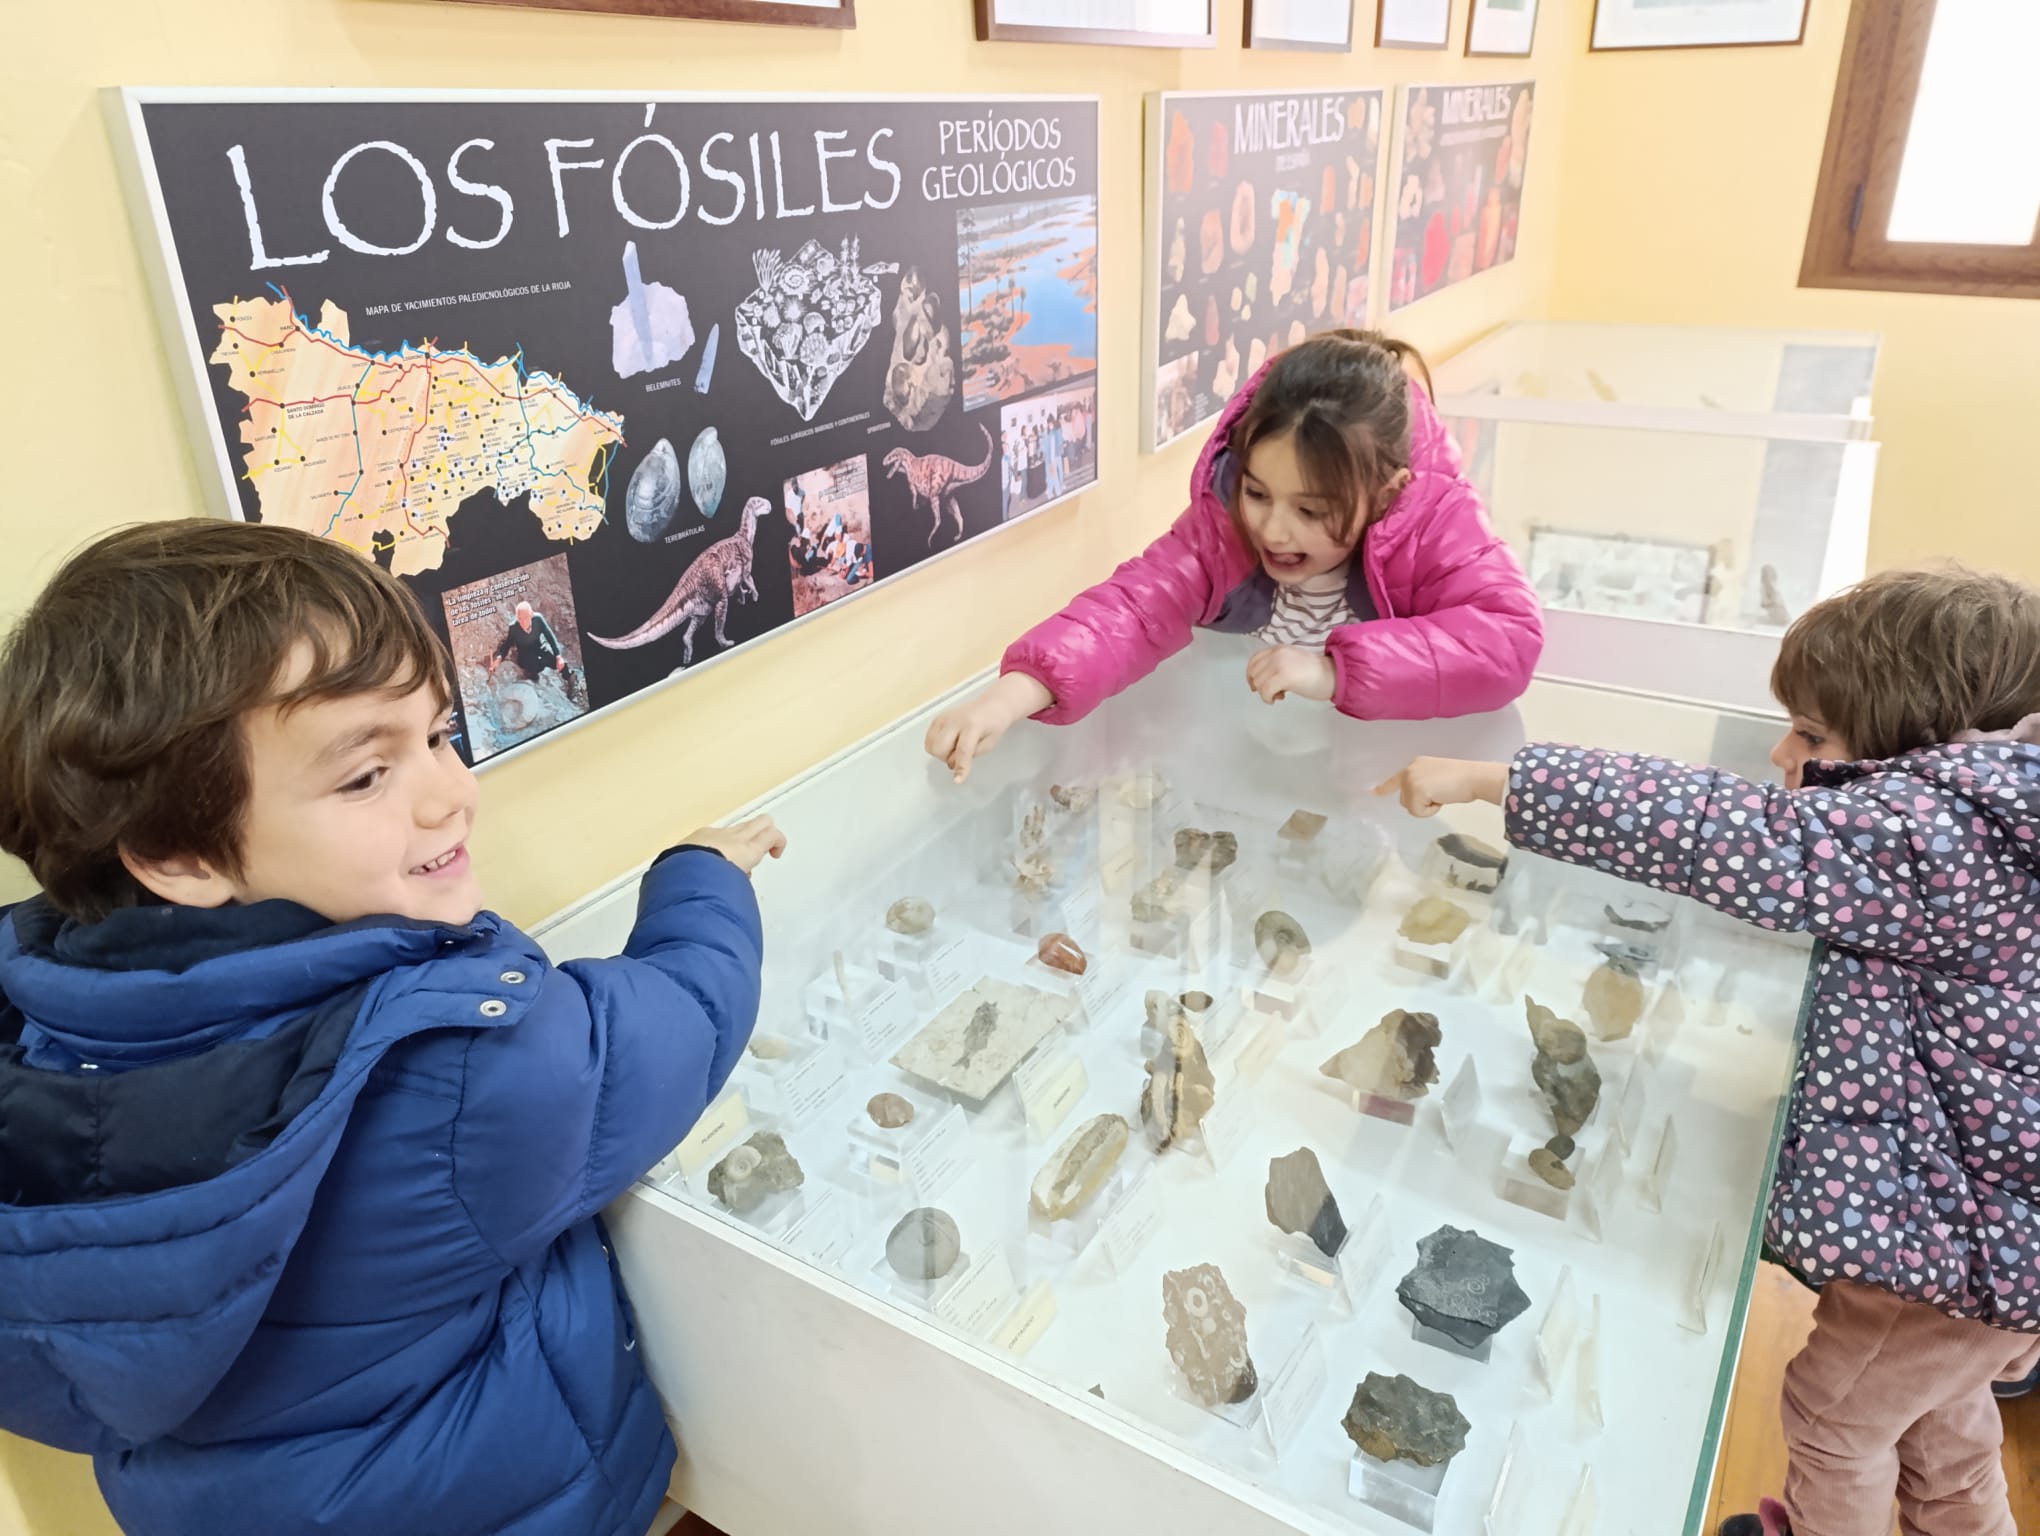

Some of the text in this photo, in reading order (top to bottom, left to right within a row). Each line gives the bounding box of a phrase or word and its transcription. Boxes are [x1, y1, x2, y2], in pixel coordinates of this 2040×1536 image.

[938, 109, 1062, 155] PERÍODOS
[1234, 96, 1345, 154] MINERALES
[226, 103, 901, 270] LOS FÓSILES
[922, 149, 1077, 202] GEOLÓGICOS
[365, 281, 572, 316] MAPA DE YACIMIENTOS PALEOICNOLÓGICOS DE LA RIOJA
[450, 607, 459, 616] de
[470, 611, 478, 619] de
